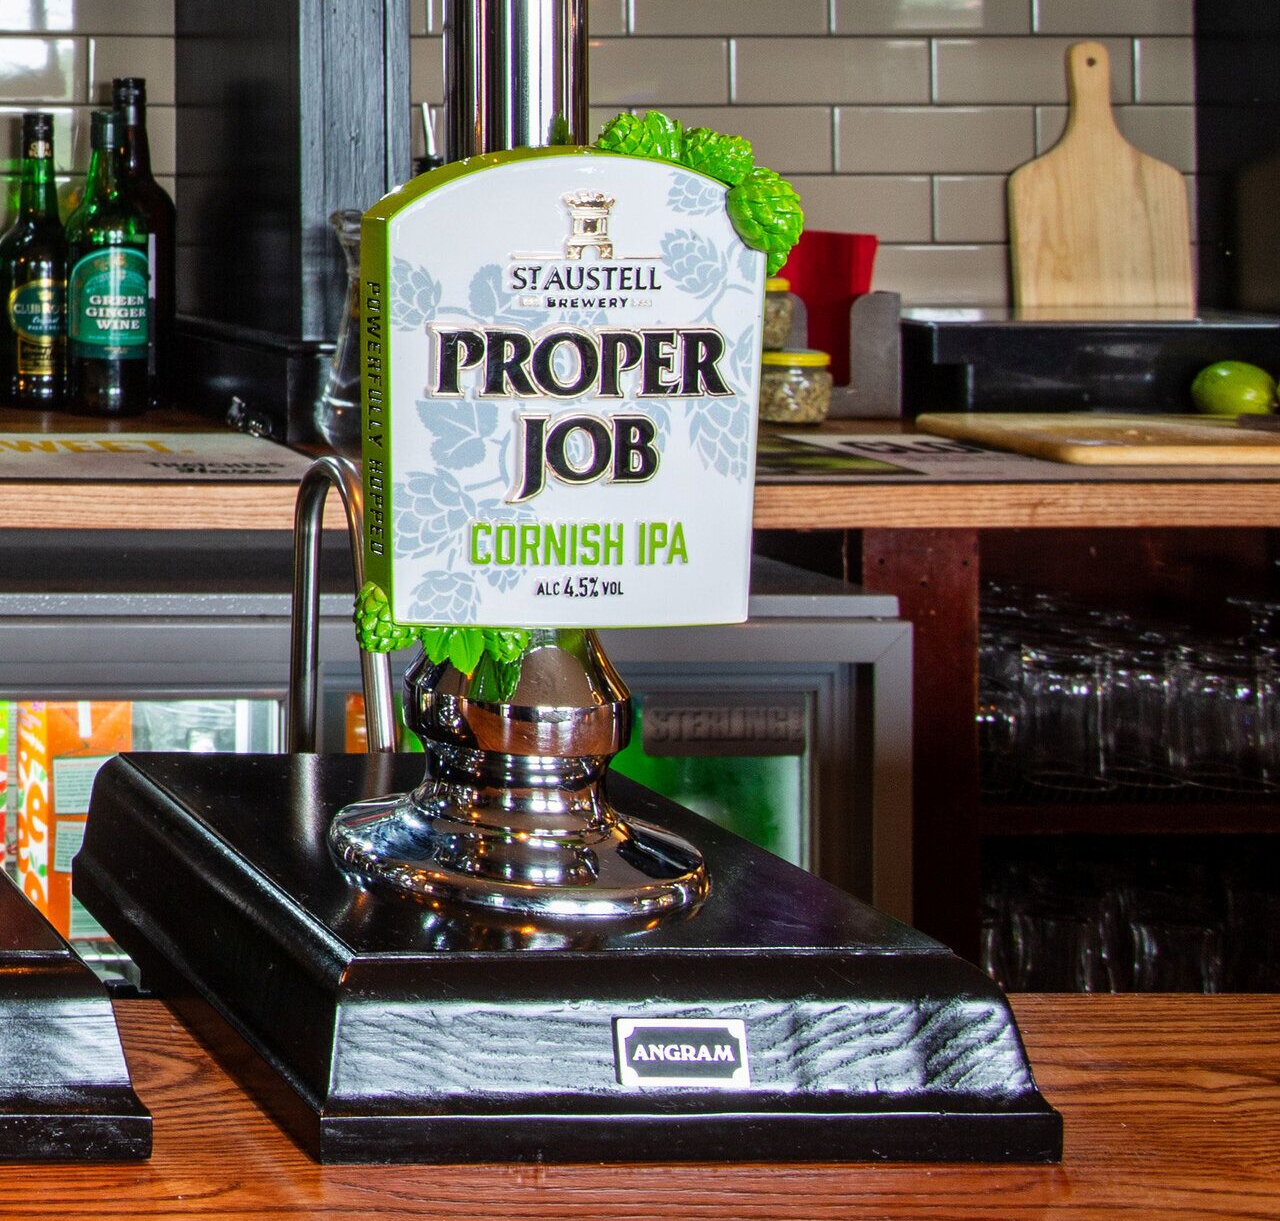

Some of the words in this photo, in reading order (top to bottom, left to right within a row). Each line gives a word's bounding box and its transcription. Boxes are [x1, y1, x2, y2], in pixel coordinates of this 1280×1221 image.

[543, 265, 662, 291] AUSTELL
[85, 306, 146, 318] GINGER
[89, 294, 145, 306] GREEN
[546, 297, 629, 308] BREWERY
[96, 319, 140, 330] WINE
[366, 281, 383, 449] POWERFULLY
[427, 321, 735, 399] PROPER
[505, 410, 660, 505] JOB
[368, 458, 385, 557] HOPPED
[469, 521, 625, 566] CORNISH
[638, 521, 690, 566] IPA
[536, 581, 561, 597] ALC
[562, 576, 600, 599] 4.5%
[601, 581, 624, 597] VOL
[631, 1043, 735, 1066] ANGRAM
